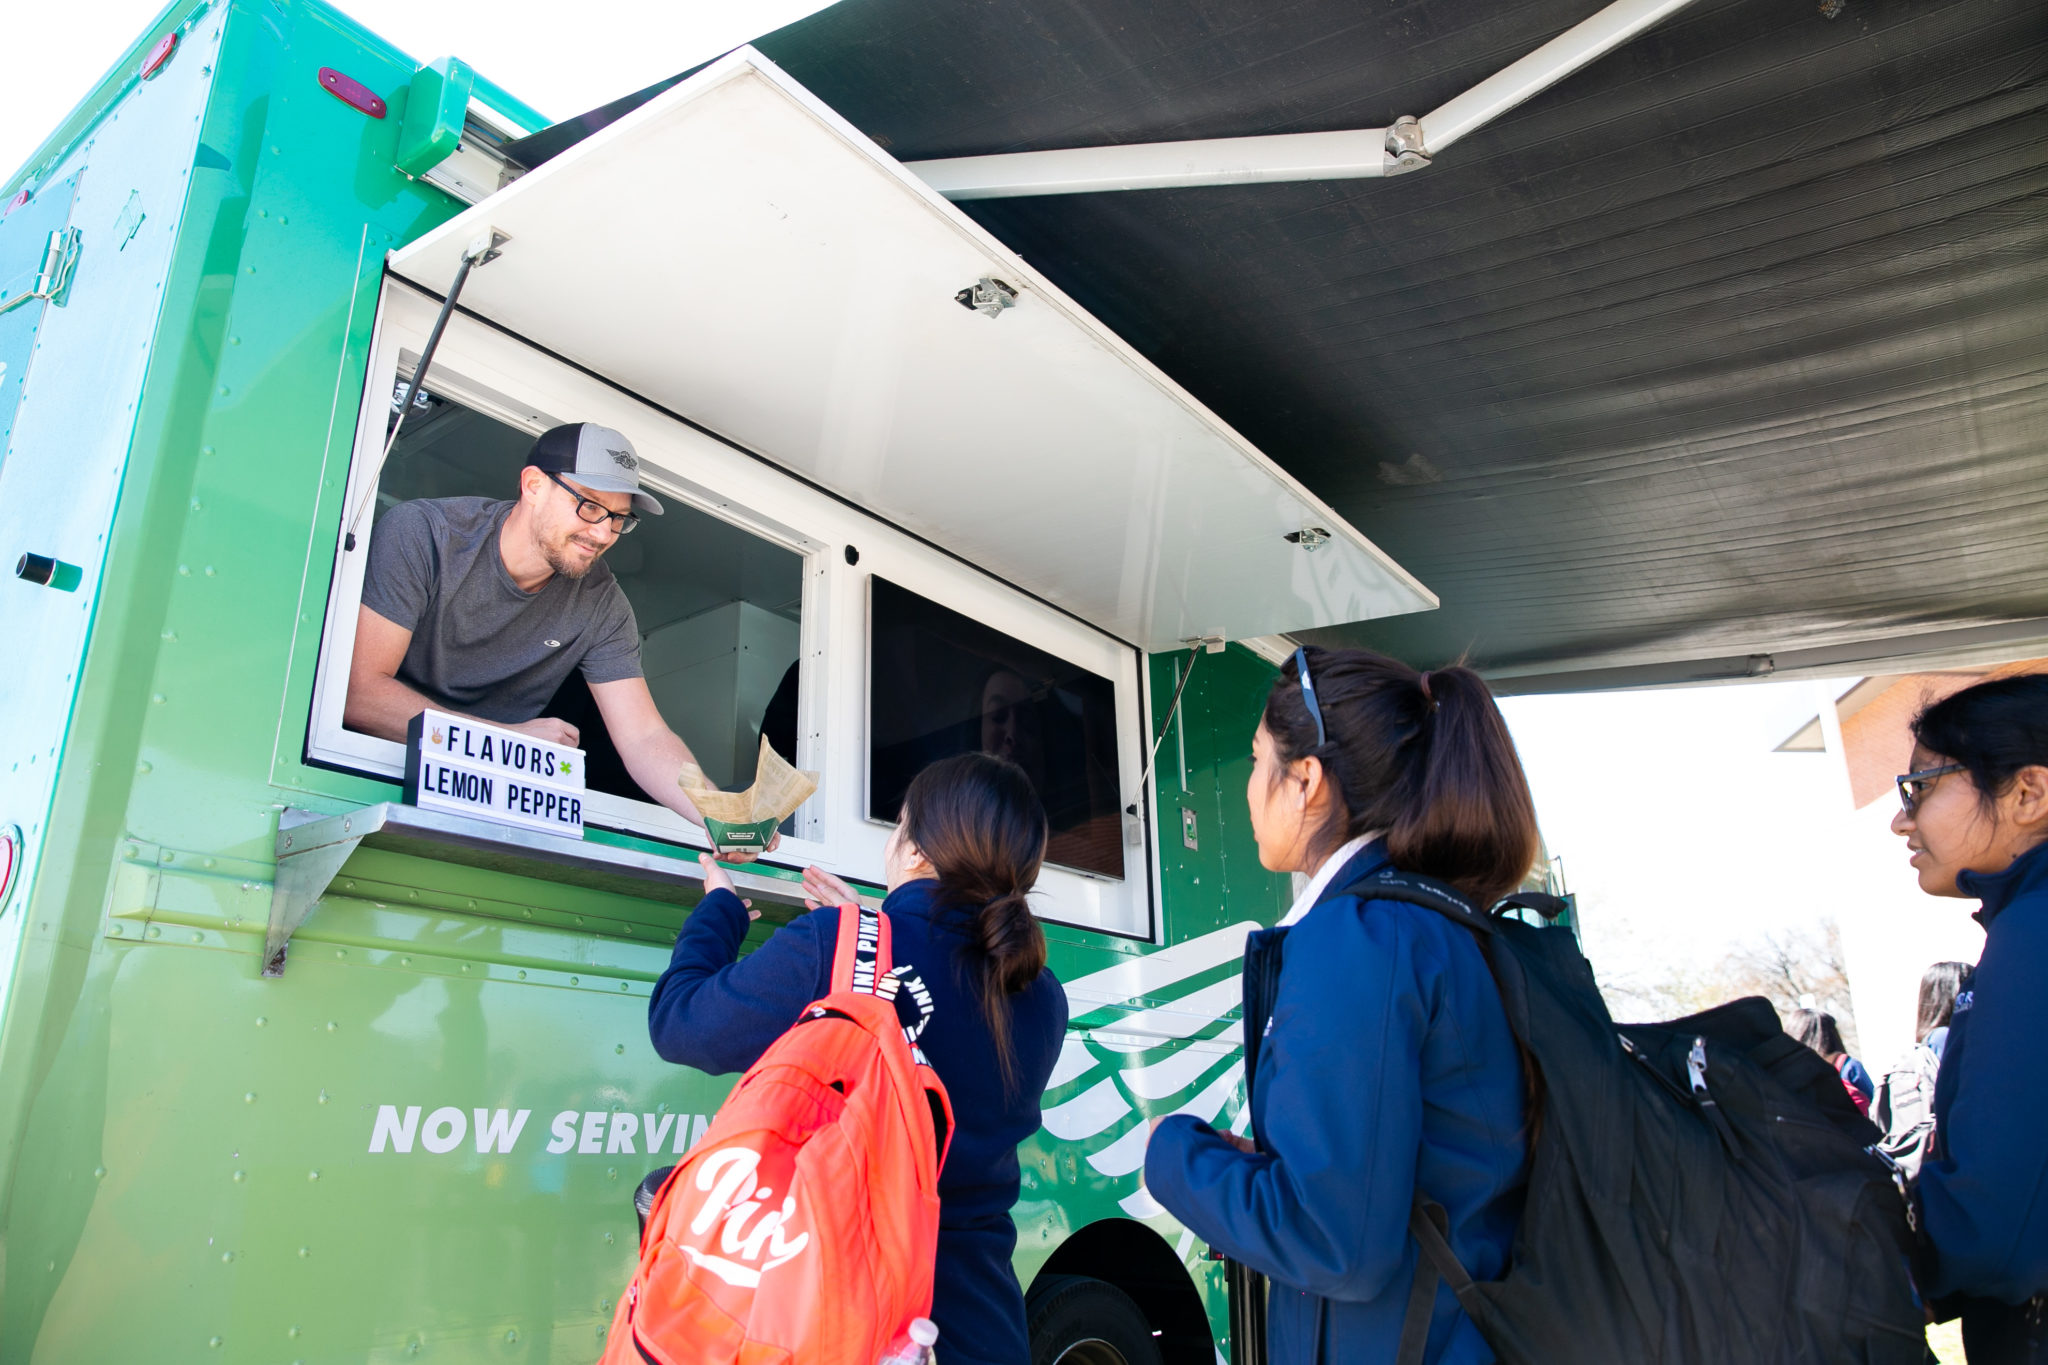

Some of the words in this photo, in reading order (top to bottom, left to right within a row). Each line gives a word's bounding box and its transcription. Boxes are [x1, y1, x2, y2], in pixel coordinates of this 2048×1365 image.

[447, 725, 555, 777] FLAVORS
[424, 763, 493, 805] LEMON
[507, 783, 581, 825] PEPPER
[857, 913, 880, 953] PINK
[852, 957, 877, 994] INK
[368, 1104, 532, 1154] NOW
[545, 1110, 718, 1154] SERVIN
